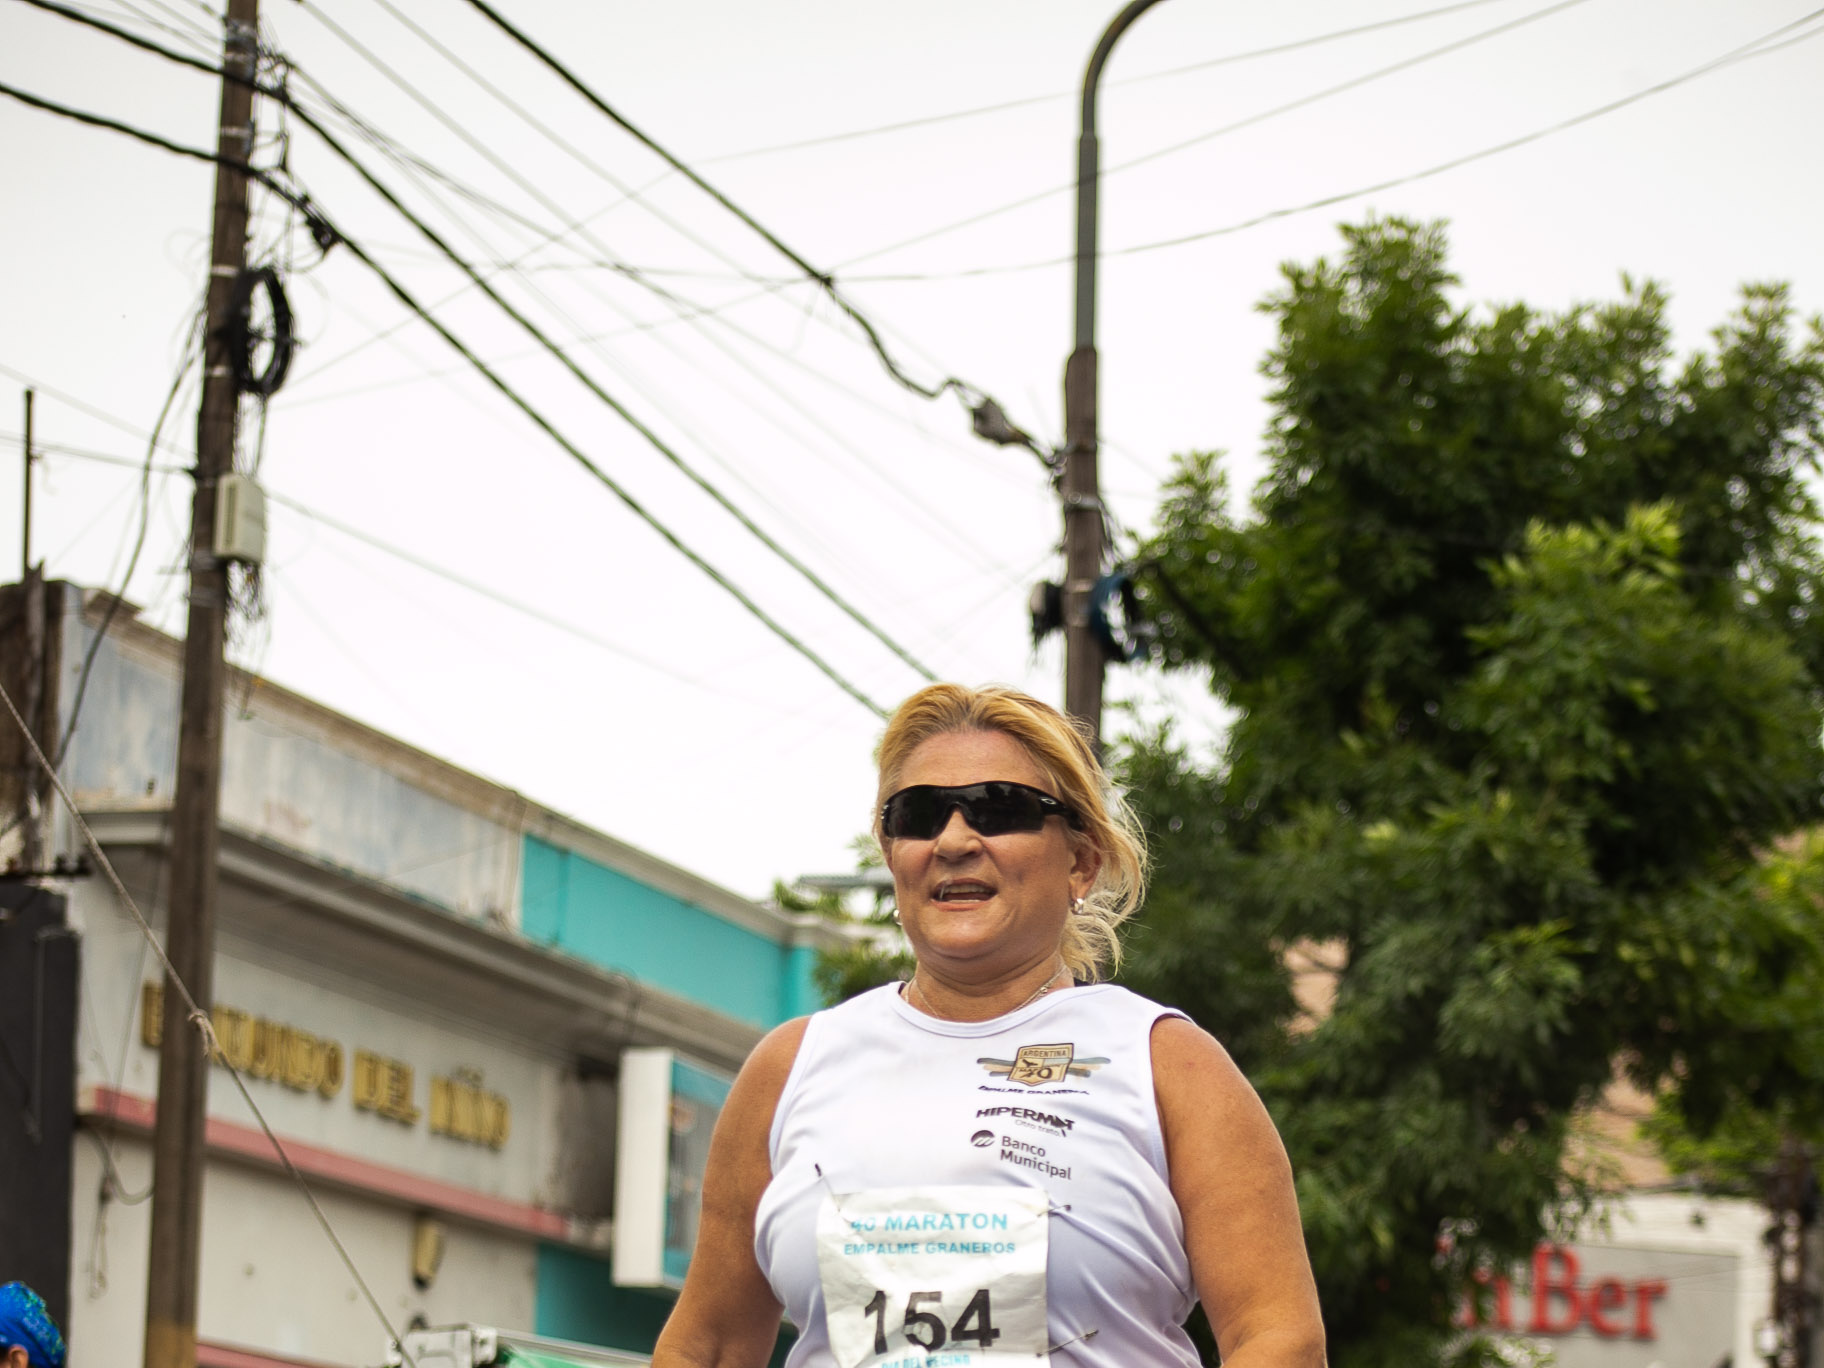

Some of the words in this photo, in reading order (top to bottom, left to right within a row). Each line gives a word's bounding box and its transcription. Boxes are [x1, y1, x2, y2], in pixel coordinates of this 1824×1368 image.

[1022, 1050, 1067, 1058] ARGENTINA
[1001, 1135, 1047, 1158] Banco
[1000, 1149, 1073, 1181] Municipal
[885, 1212, 1009, 1231] MARATON
[844, 1242, 920, 1256] EMPALME
[925, 1241, 1017, 1255] GRANEROS
[864, 1288, 1001, 1356] 154
